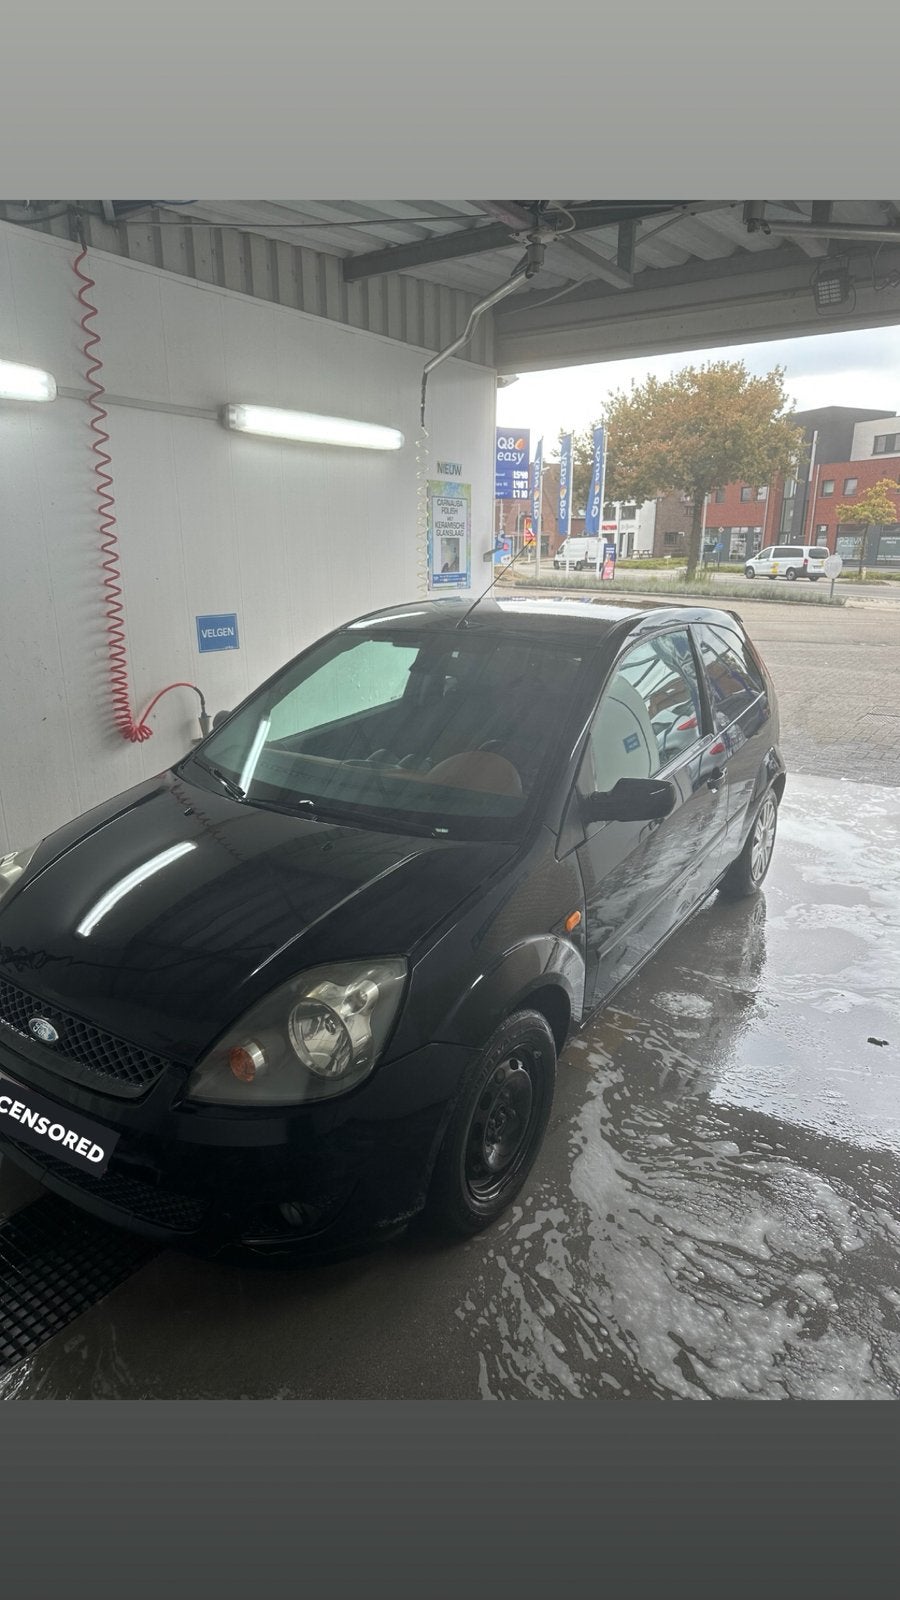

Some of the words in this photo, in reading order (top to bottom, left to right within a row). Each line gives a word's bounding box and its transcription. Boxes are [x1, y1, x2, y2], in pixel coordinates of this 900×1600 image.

[497, 437, 515, 449] Q8
[497, 451, 525, 465] easy
[437, 462, 462, 476] NIEUW
[435, 521, 465, 529] KERAMISCHE
[201, 626, 234, 638] VELGEN
